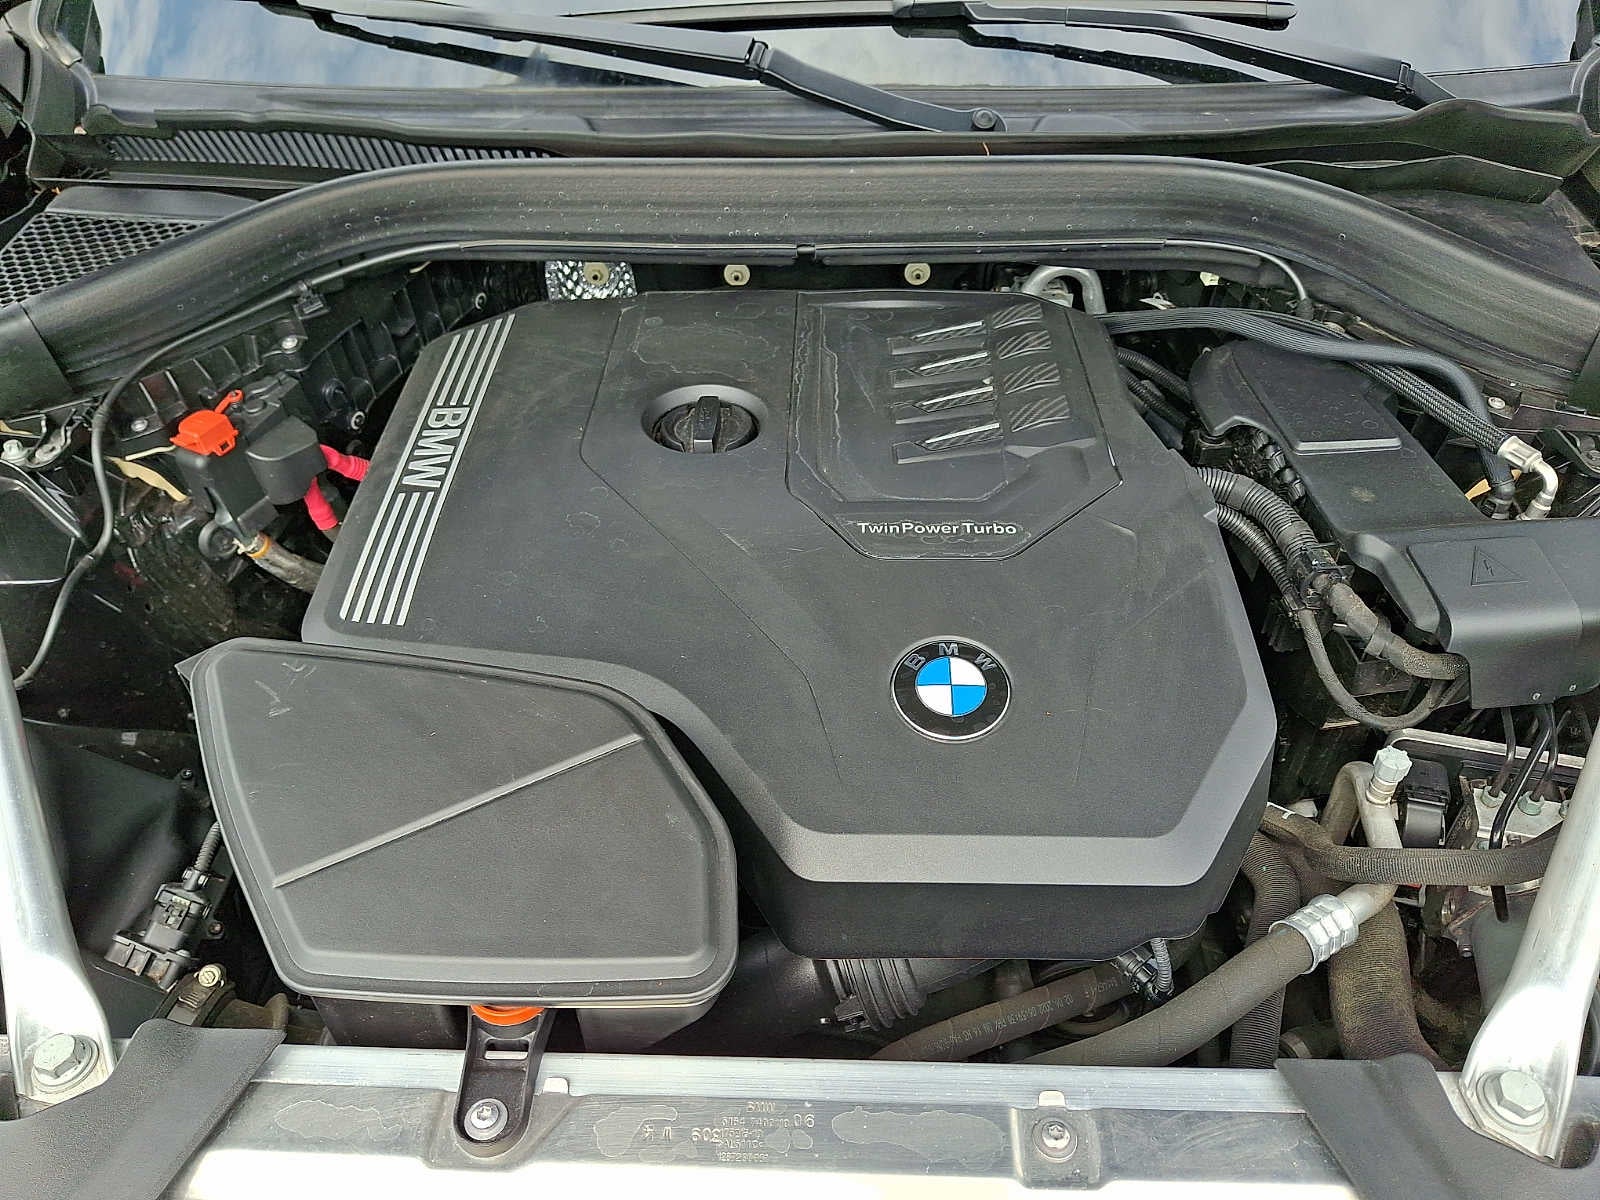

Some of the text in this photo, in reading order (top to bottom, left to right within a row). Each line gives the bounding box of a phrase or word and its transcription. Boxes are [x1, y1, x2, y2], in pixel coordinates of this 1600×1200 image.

[402, 407, 470, 488] BMW
[962, 522, 1017, 534] Turbo
[904, 642, 997, 671] BMW
